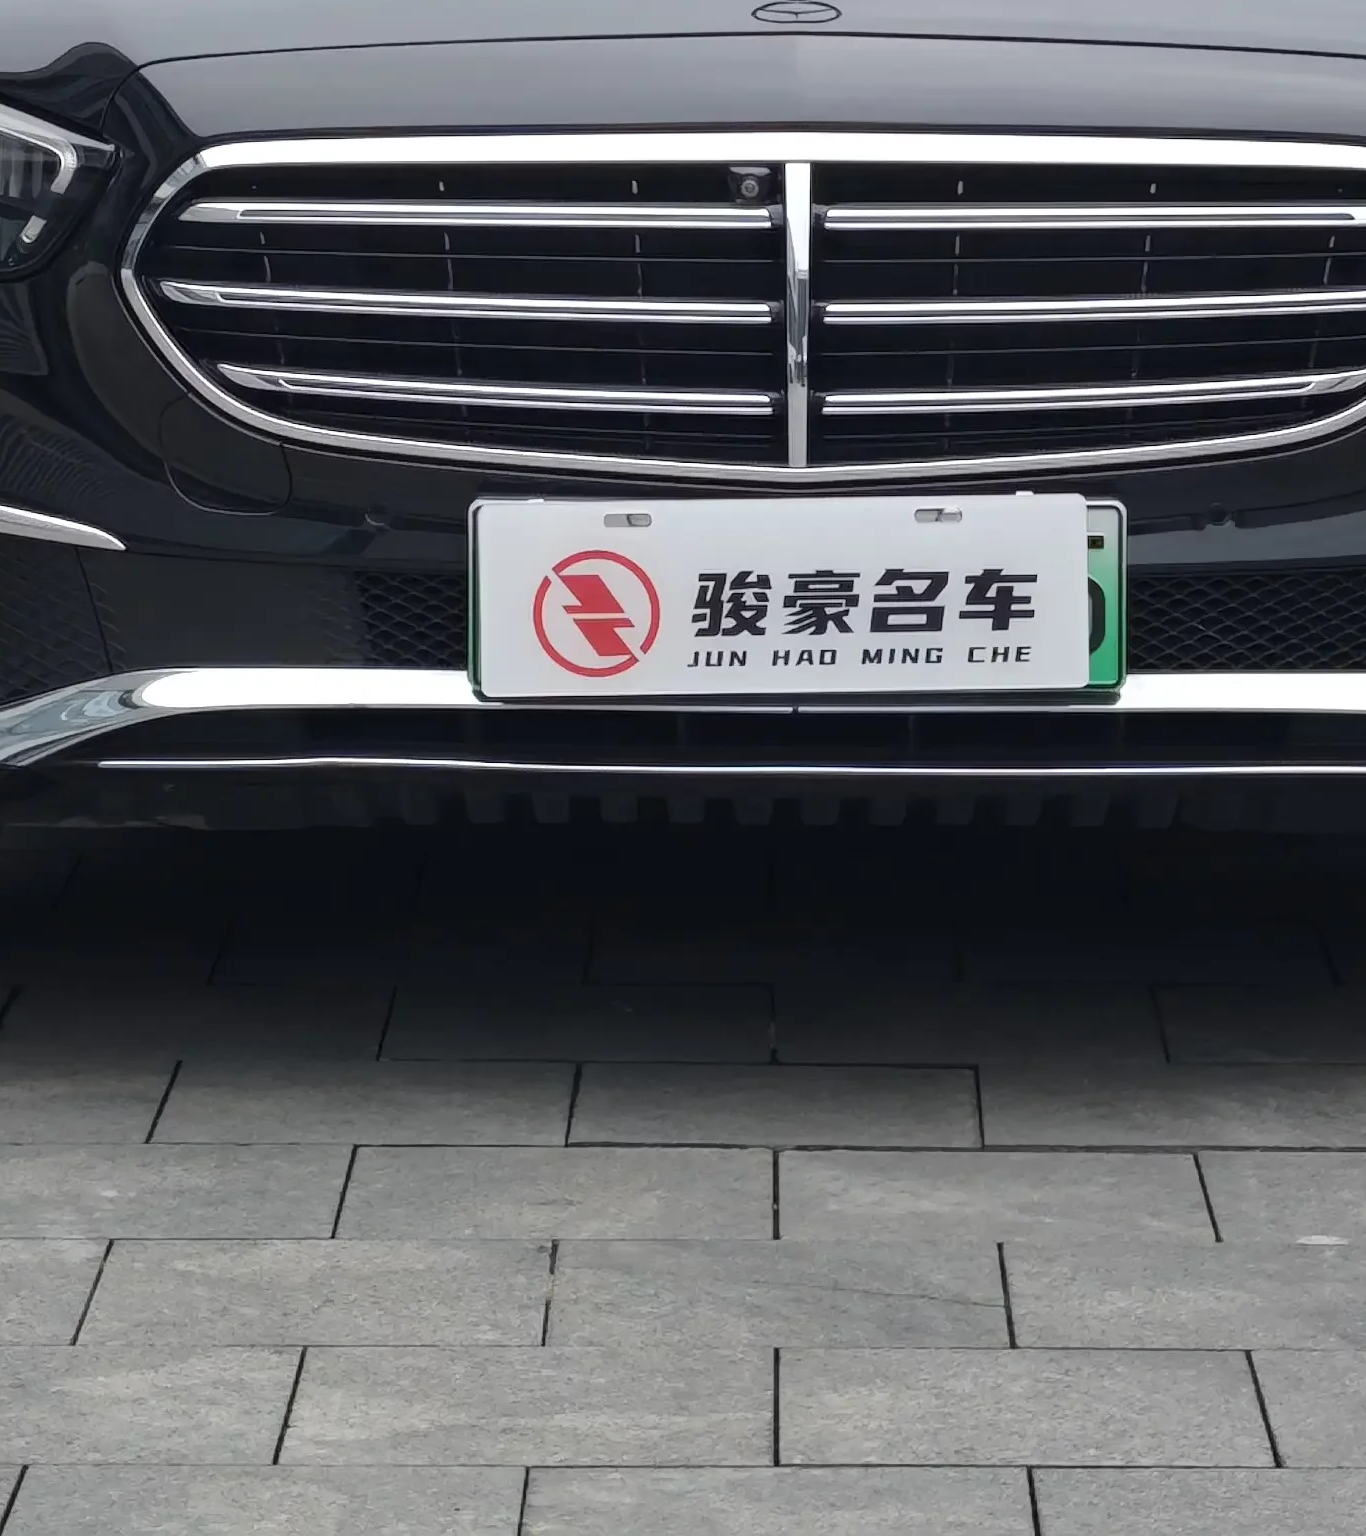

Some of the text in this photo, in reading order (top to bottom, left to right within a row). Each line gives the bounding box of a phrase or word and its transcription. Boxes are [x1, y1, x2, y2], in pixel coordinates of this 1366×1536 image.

[690, 567, 1039, 638] 骏豪名车
[687, 645, 1033, 667] JUN HAO MING CHE
